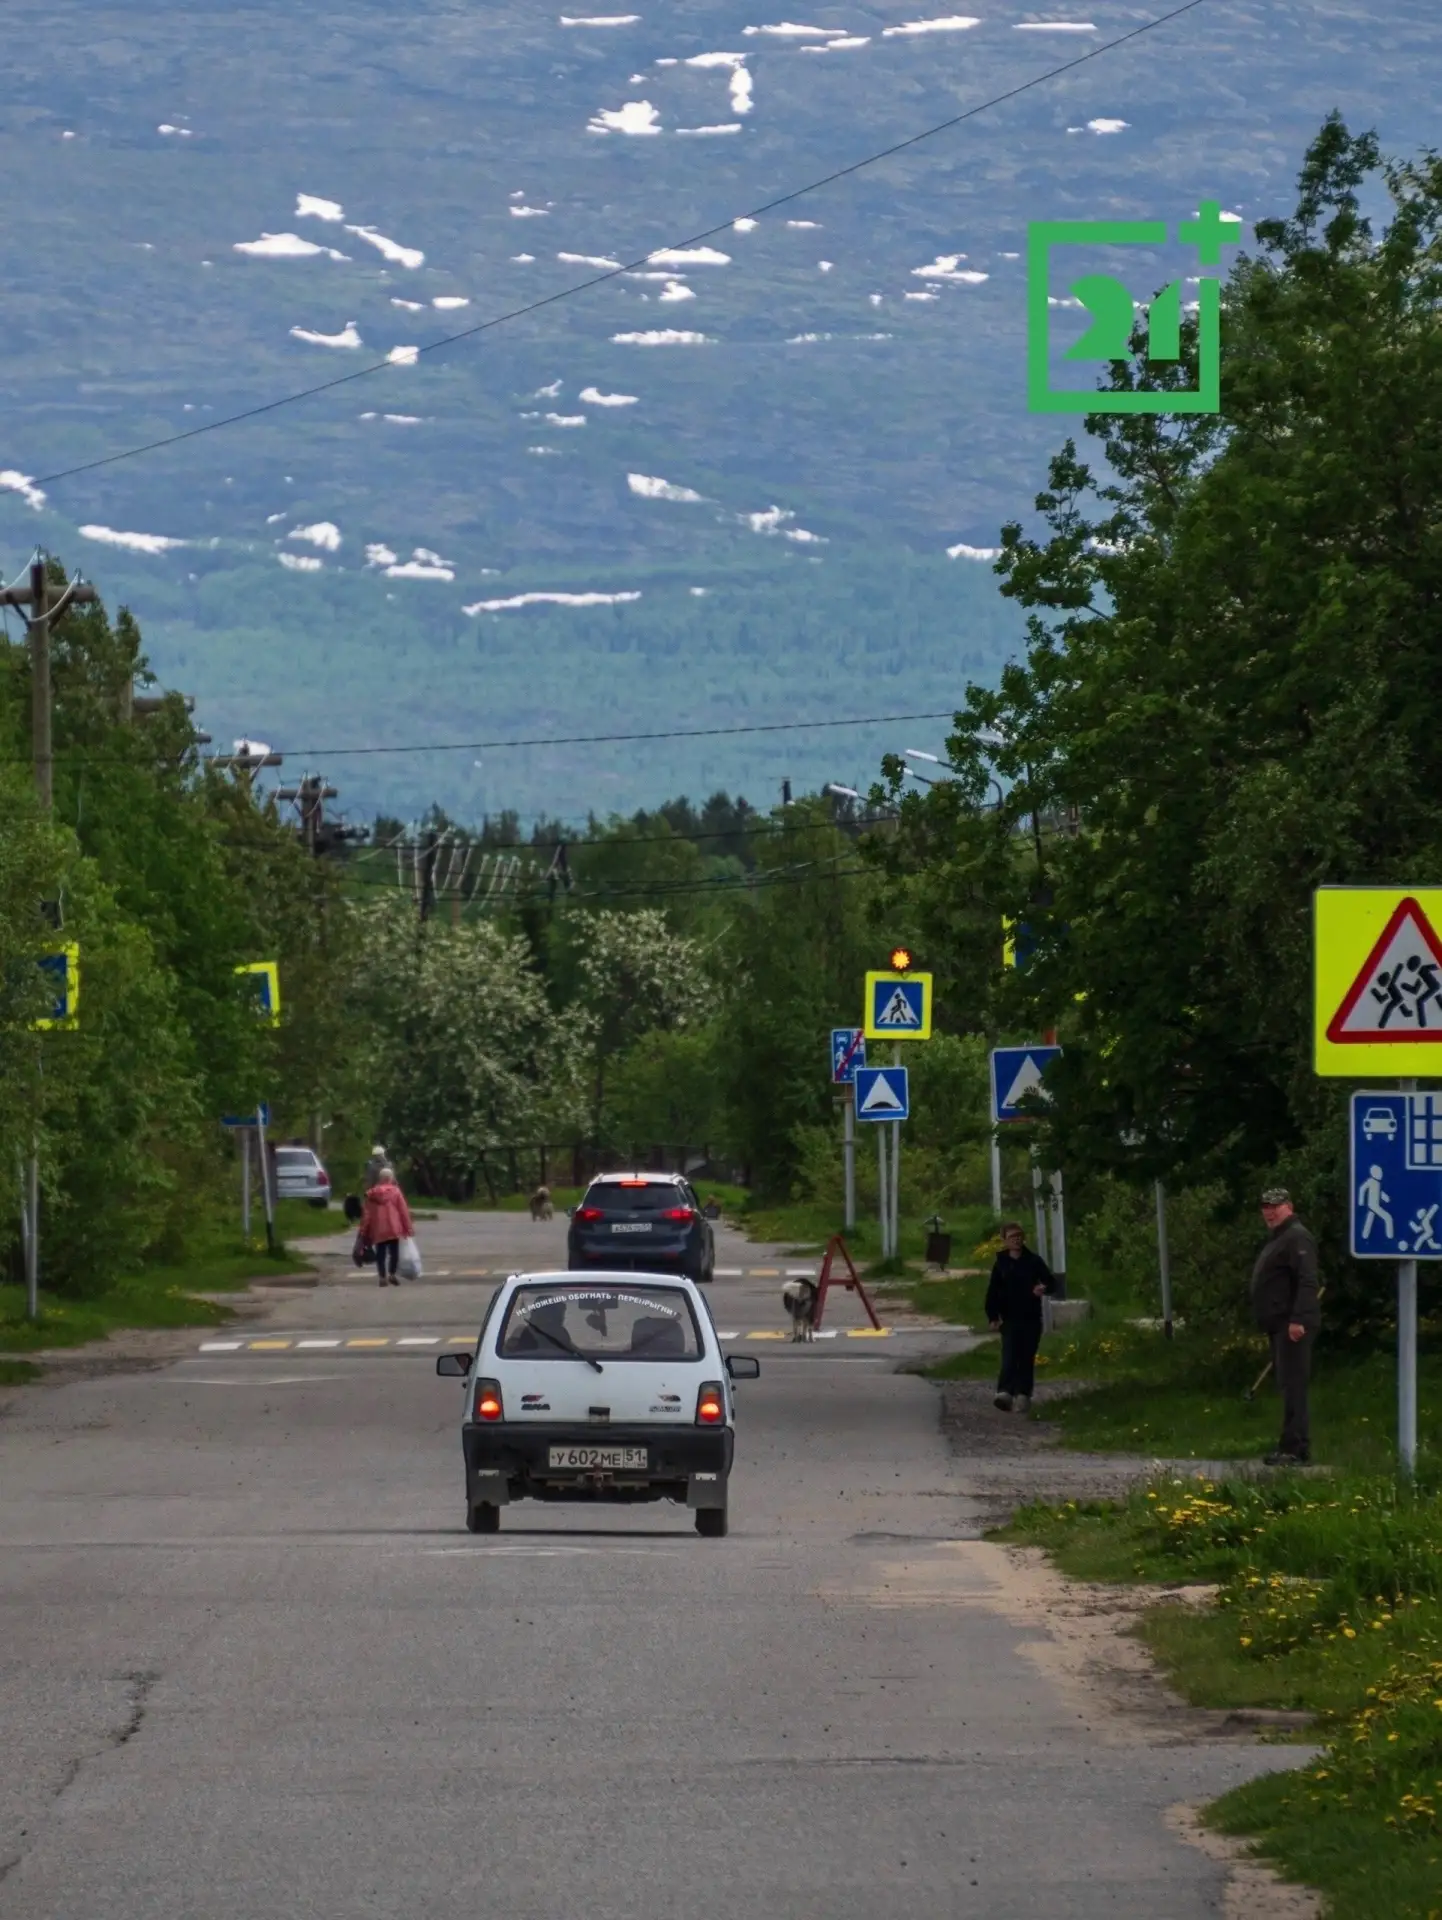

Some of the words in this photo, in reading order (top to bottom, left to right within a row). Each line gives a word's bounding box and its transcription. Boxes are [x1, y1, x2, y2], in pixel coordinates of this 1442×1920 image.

[516, 1307, 527, 1316] НЕ
[528, 1295, 567, 1312] МОЖЕШЬ
[568, 1292, 611, 1301] ОБОГНАТЬ
